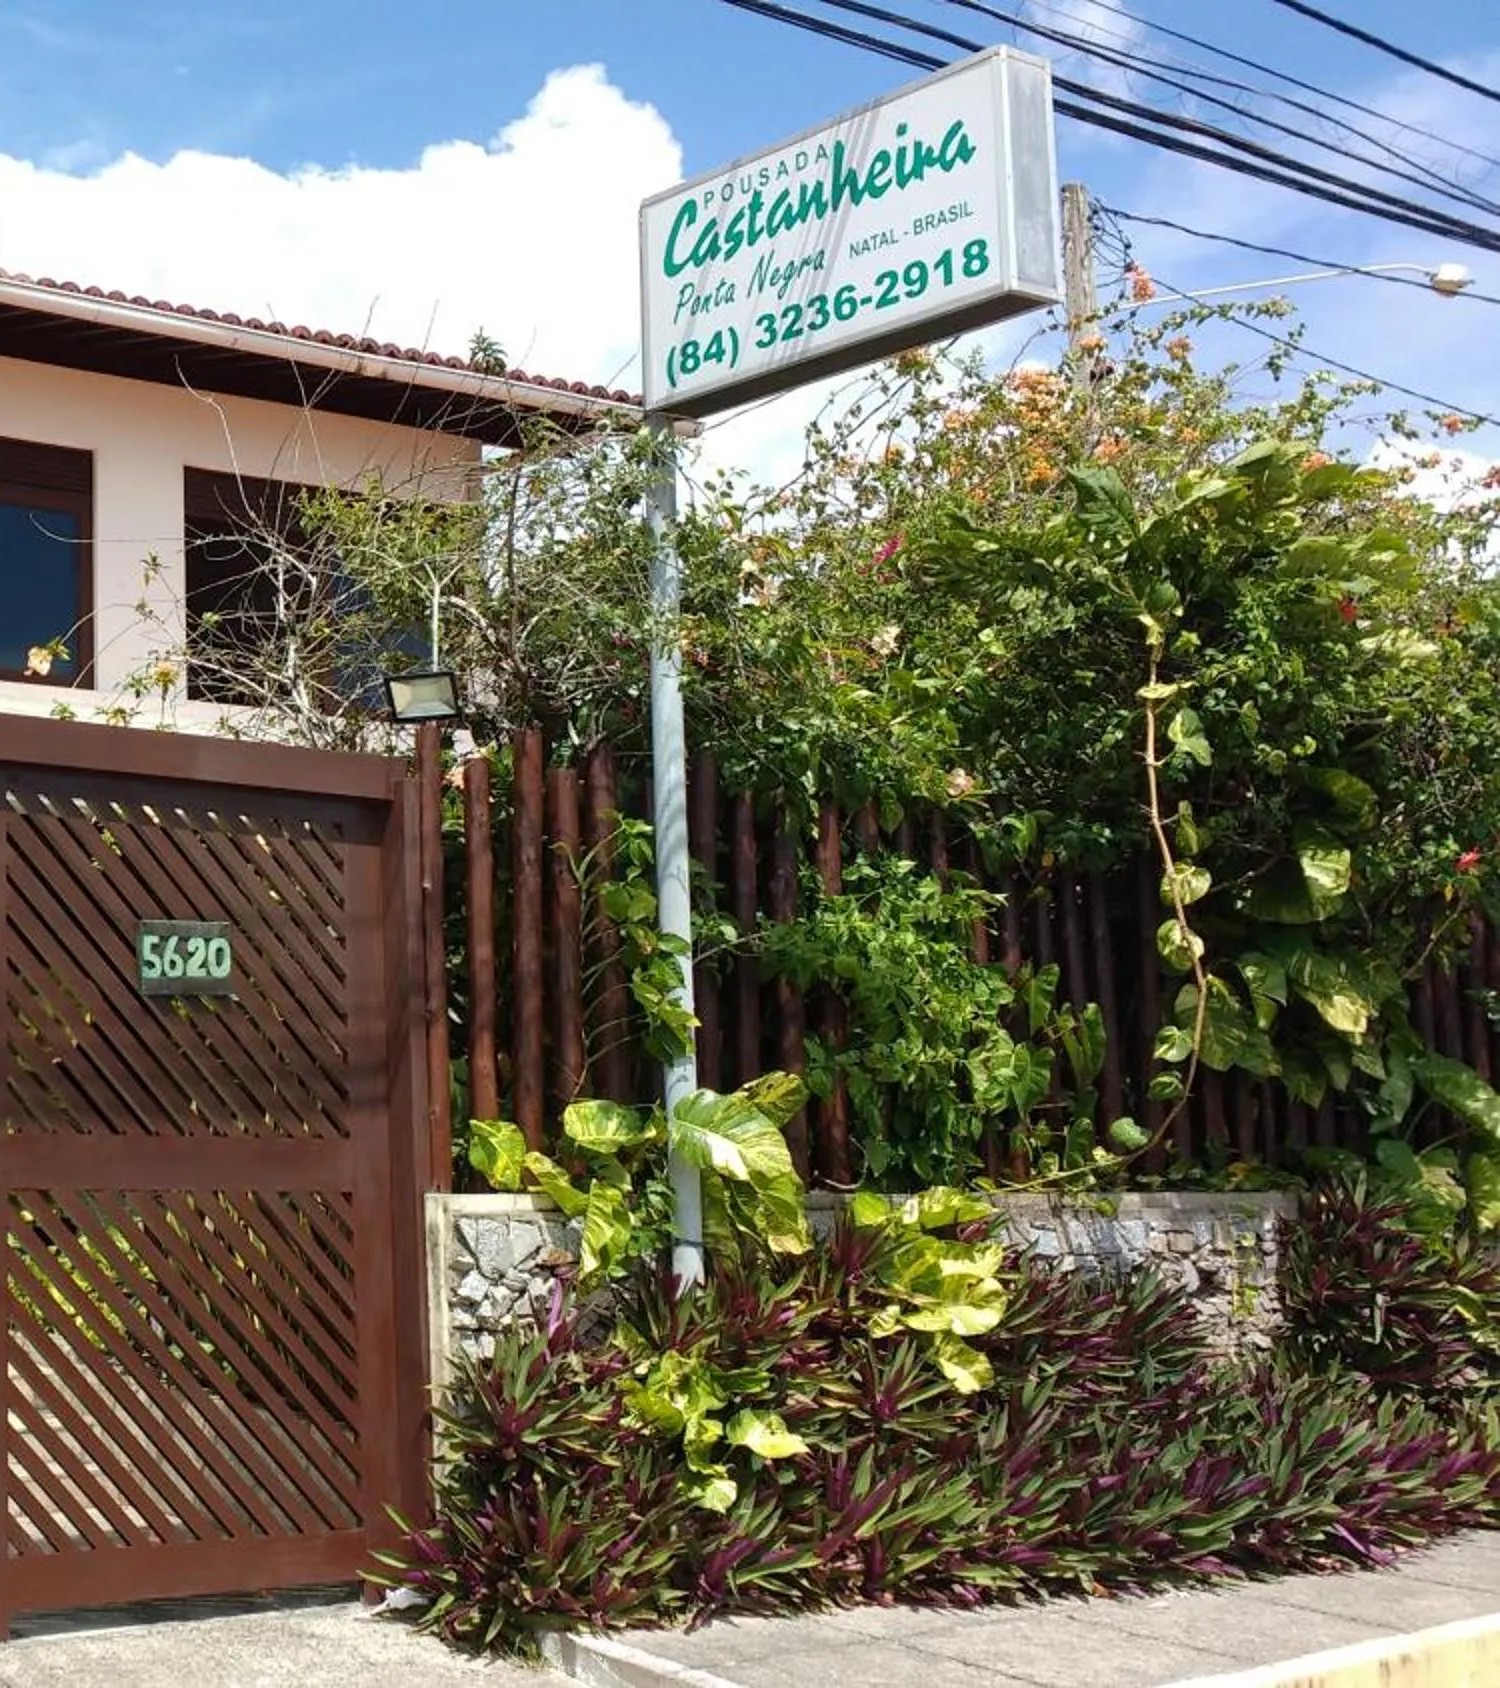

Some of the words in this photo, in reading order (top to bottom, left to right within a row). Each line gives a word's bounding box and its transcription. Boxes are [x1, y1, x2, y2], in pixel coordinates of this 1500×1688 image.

[663, 120, 977, 278] Castanheira
[704, 143, 830, 209] POUSADA
[849, 229, 900, 260] NATAL
[913, 200, 974, 236] BRASIL
[666, 326, 739, 388] (84)
[755, 238, 990, 350] 3236-2918
[674, 281, 736, 325] Ponta
[746, 248, 825, 299] Negra
[142, 935, 231, 979] 5620
